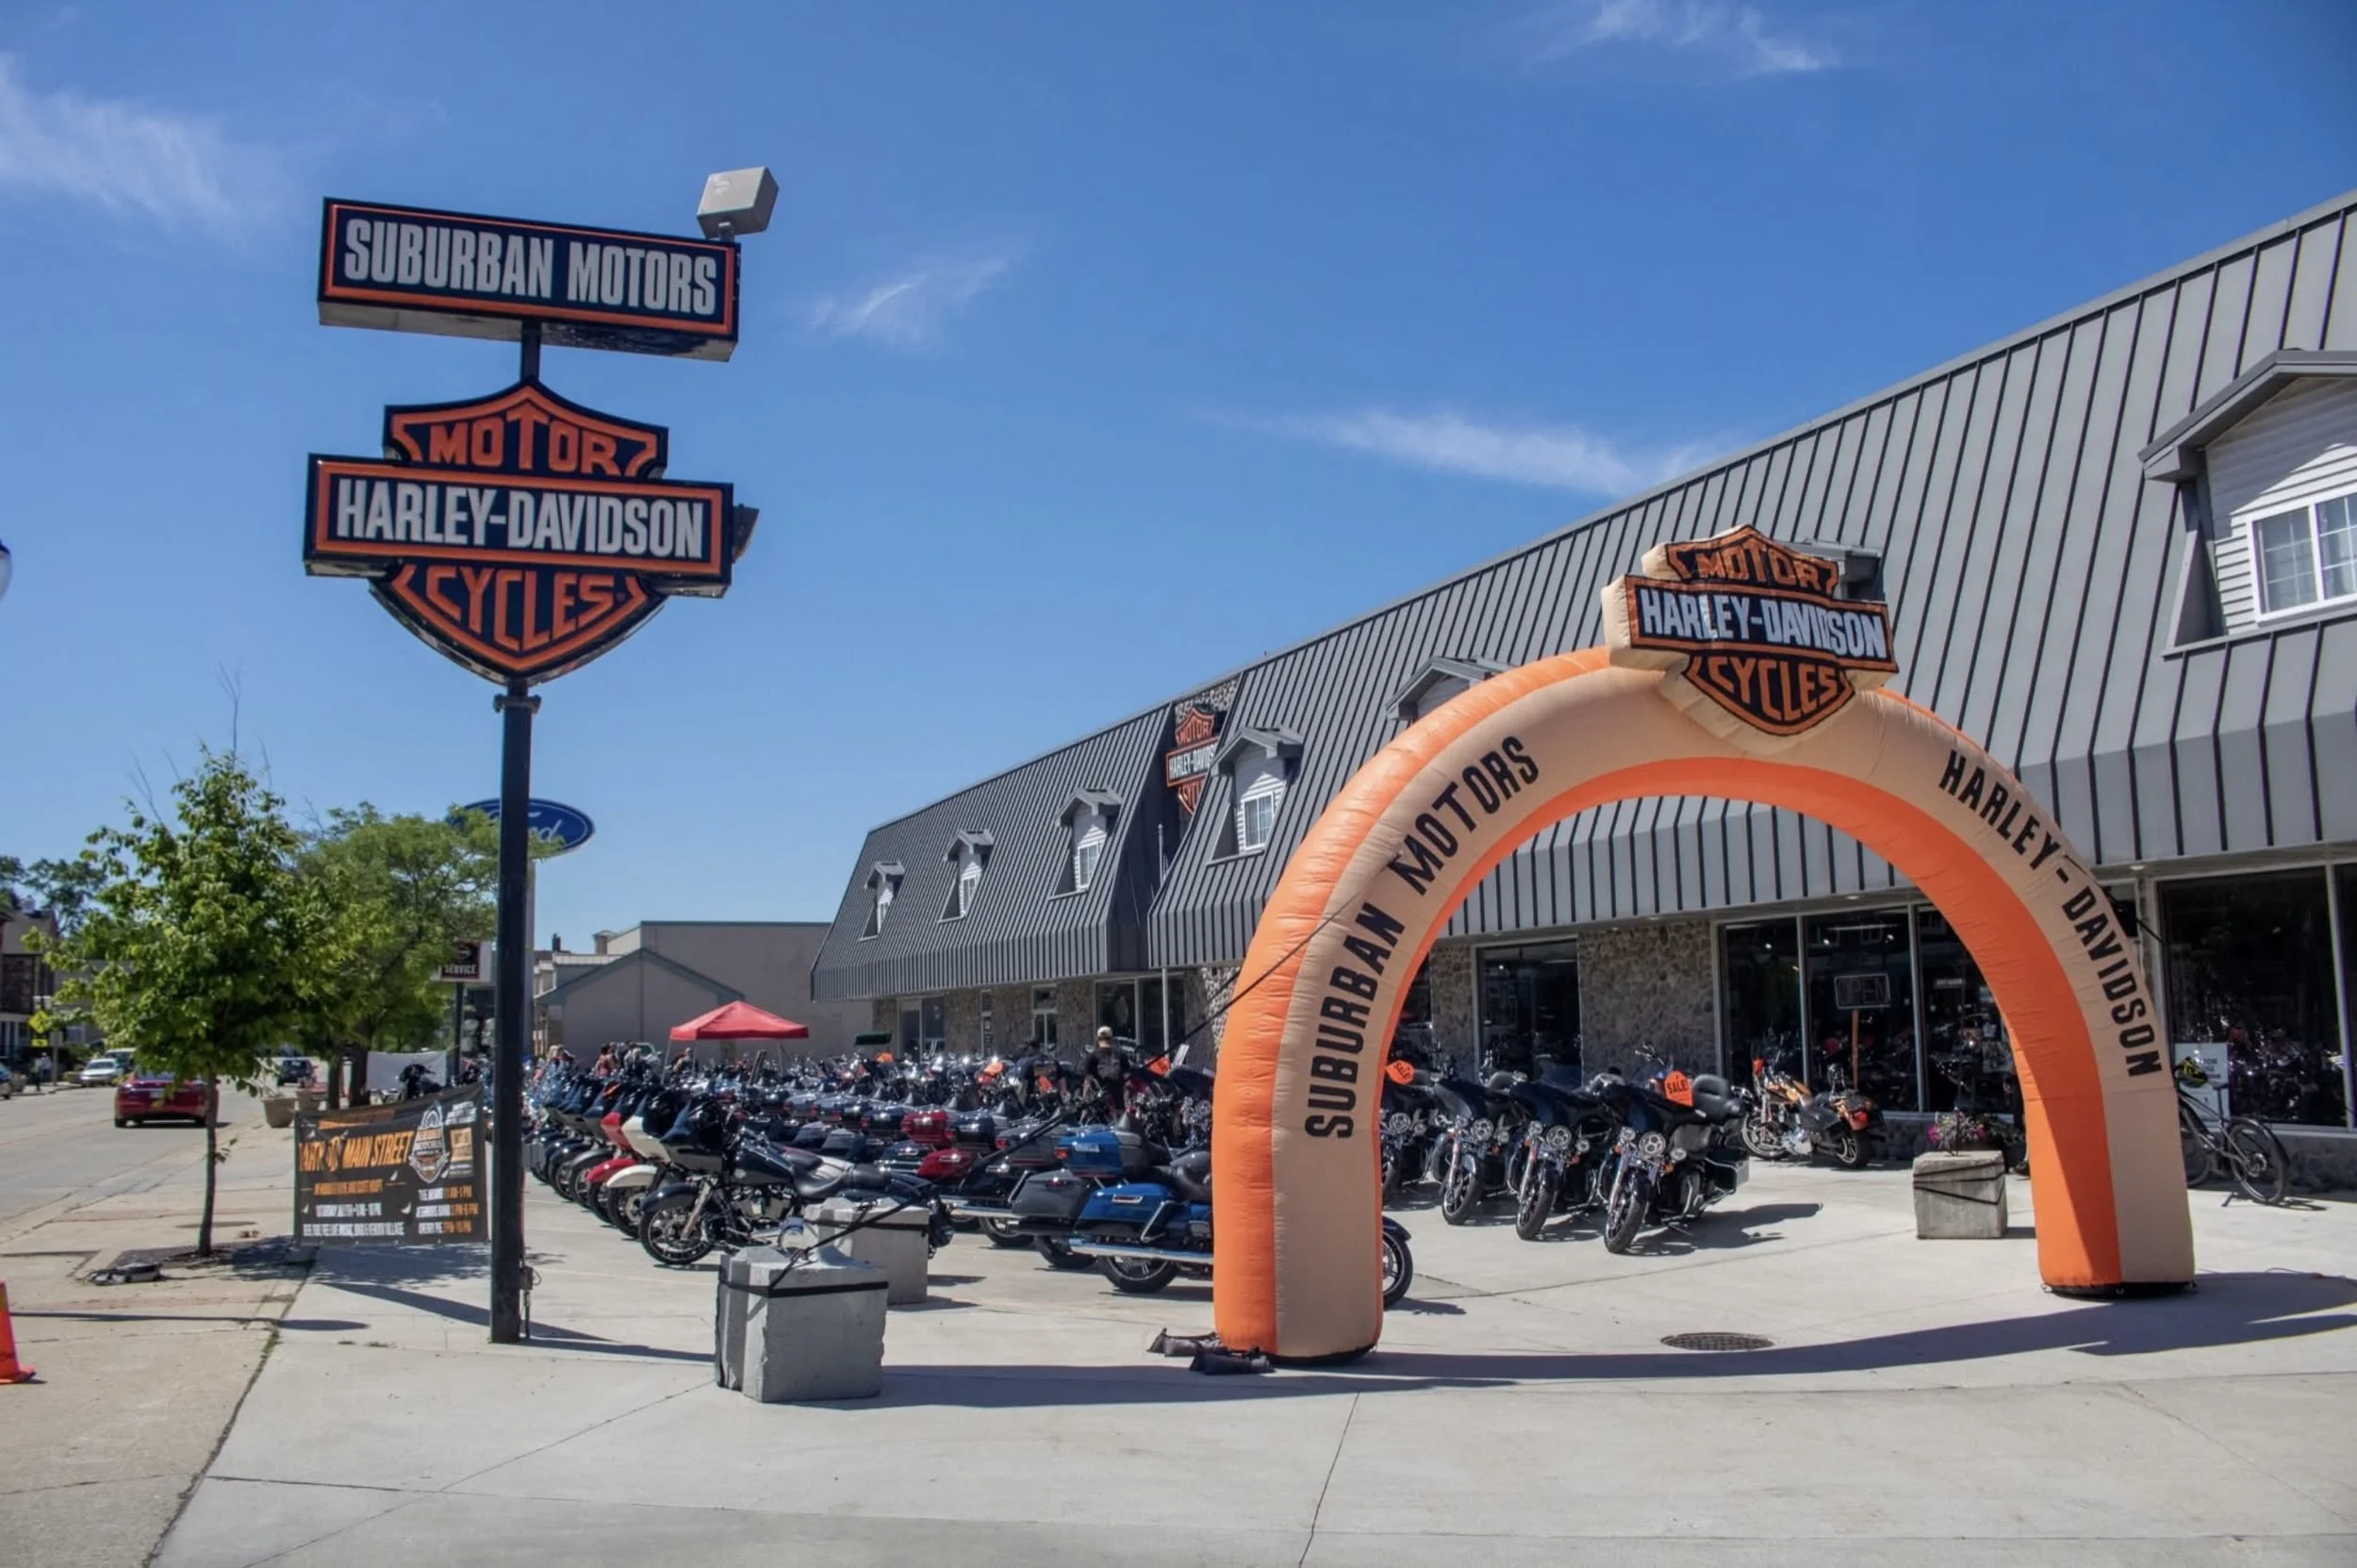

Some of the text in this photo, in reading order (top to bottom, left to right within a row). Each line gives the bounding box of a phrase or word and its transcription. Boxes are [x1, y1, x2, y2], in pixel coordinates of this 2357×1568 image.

[344, 218, 717, 316] SUBURBAN MOTORS
[429, 398, 621, 477] MOTOR
[337, 478, 704, 560] HARLEY-DAVIDSON
[1696, 536, 1821, 591] MOTOR
[425, 564, 615, 652] CYCLES
[1639, 588, 1887, 658] HARLEY-DAVIDSON
[1707, 655, 1838, 721] CYCLES
[1304, 735, 1540, 1140] SUBURBAN MOTORS
[371, 1131, 415, 1167] STREET
